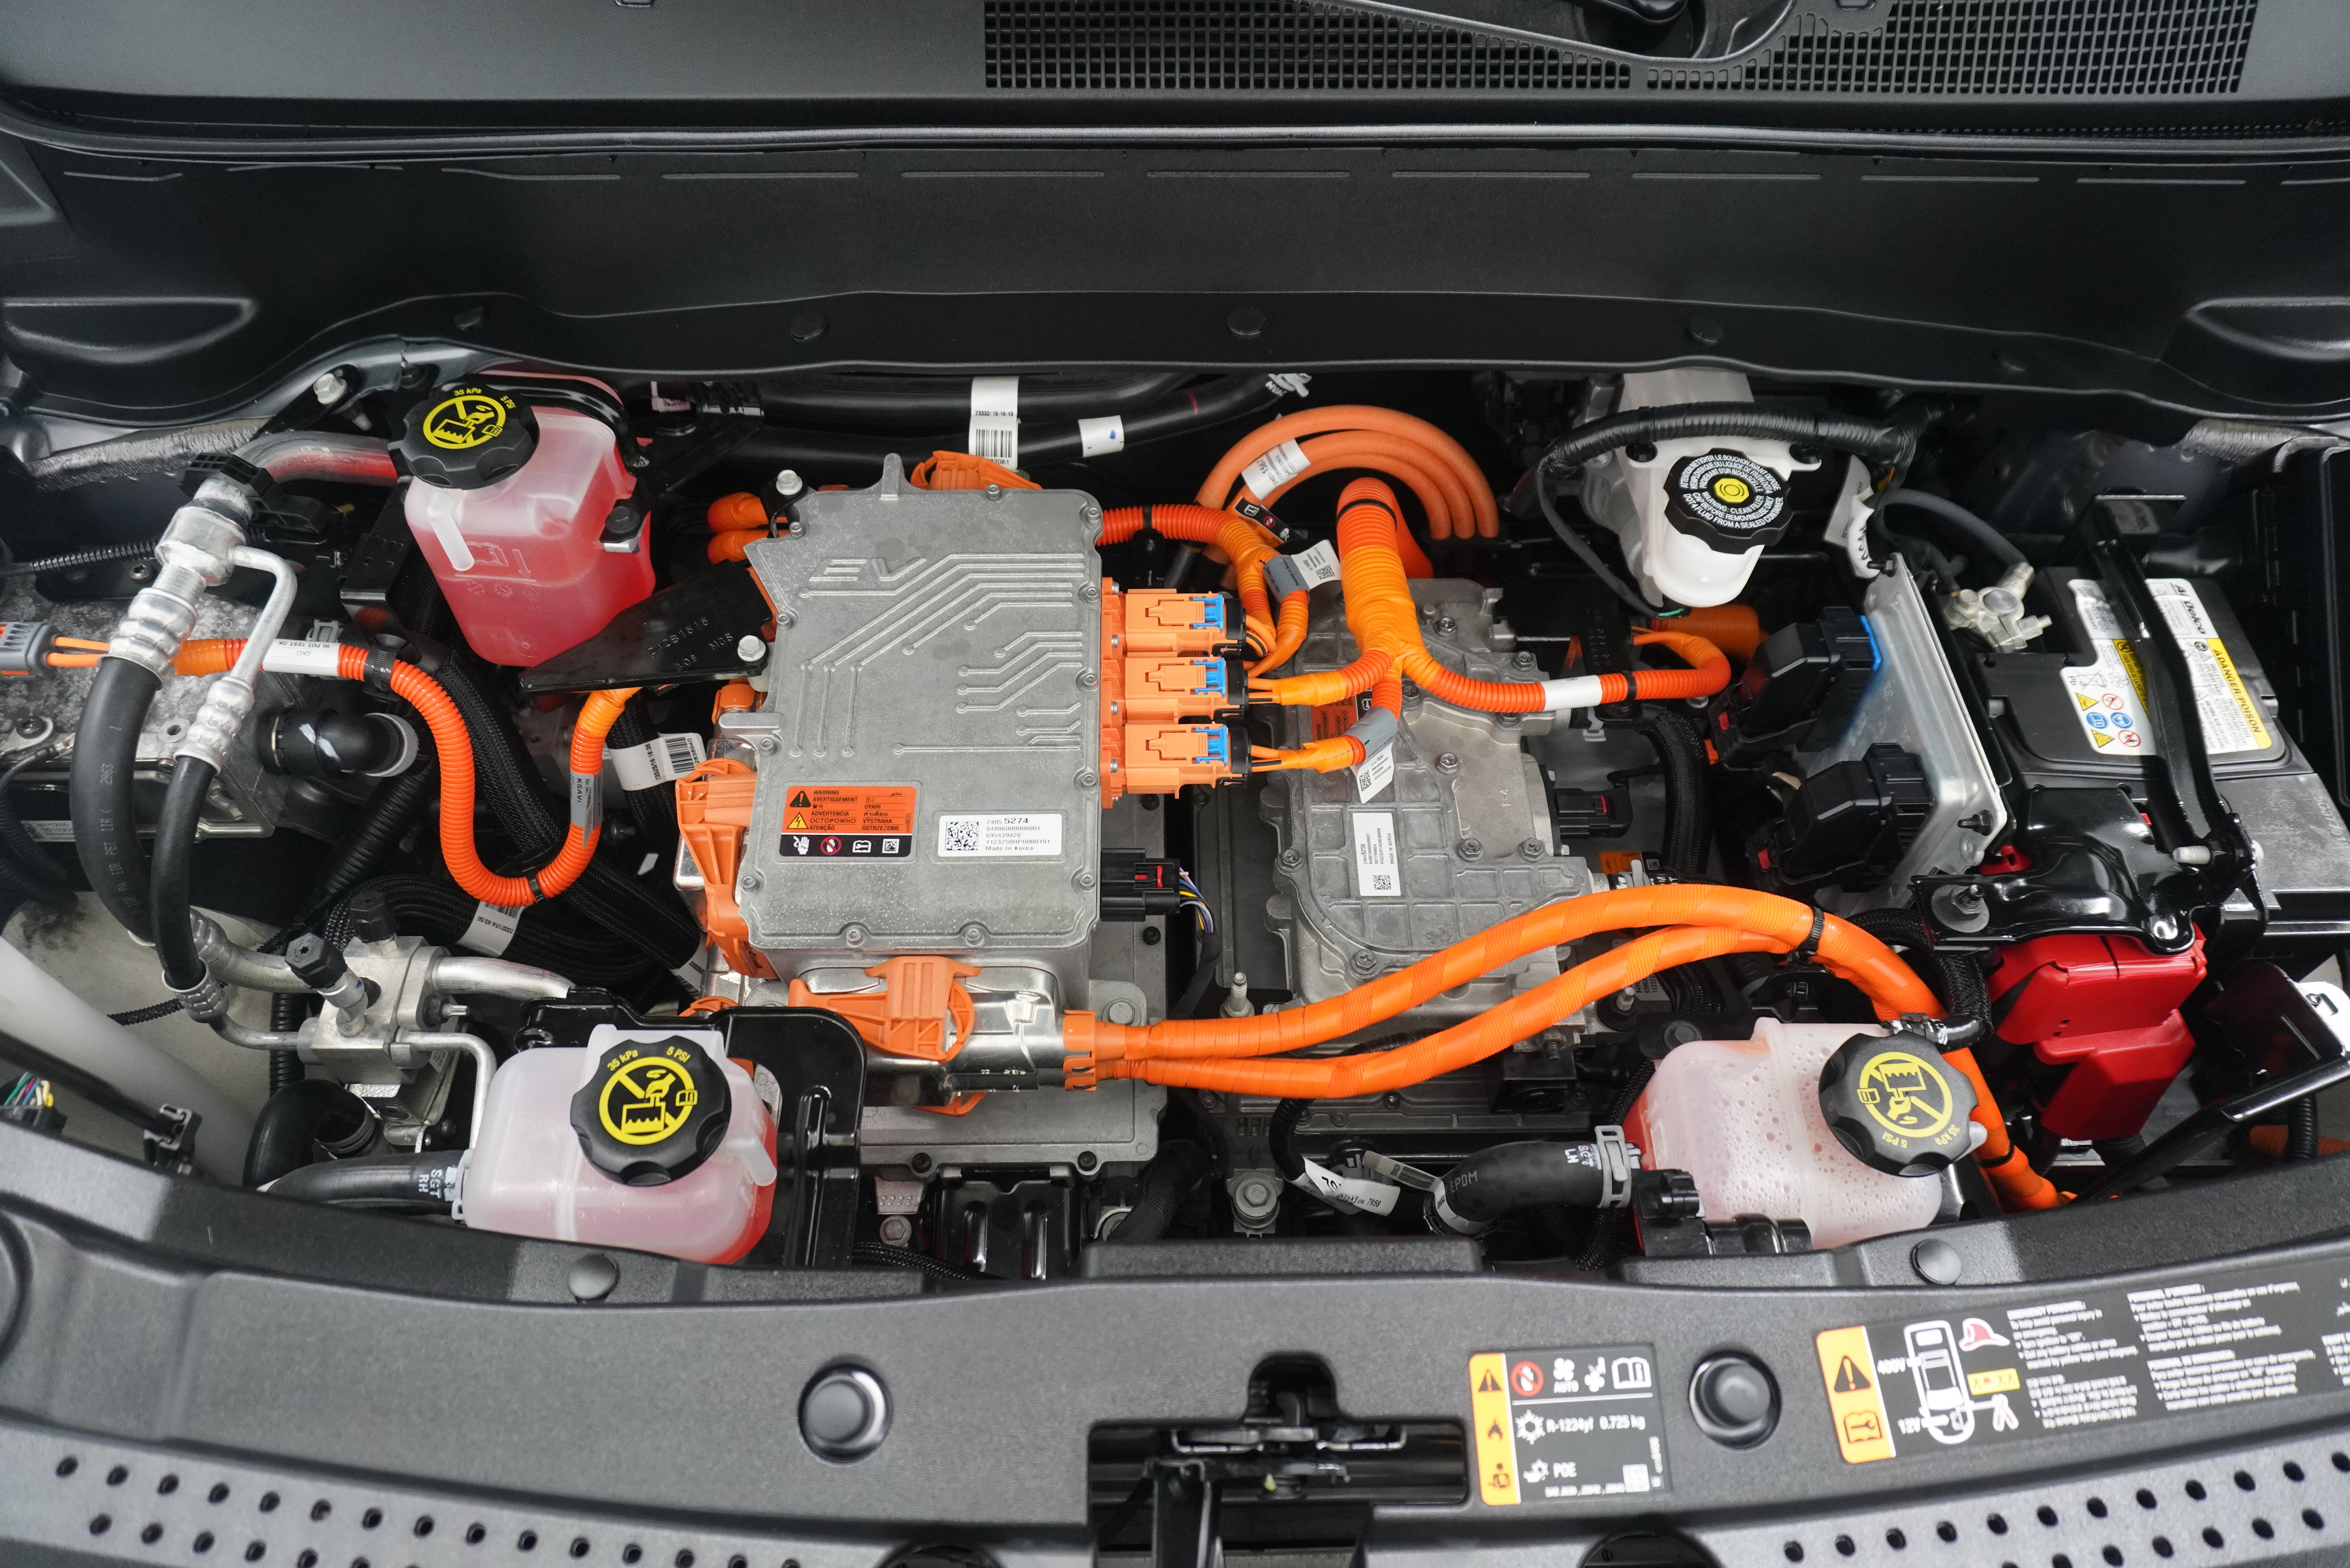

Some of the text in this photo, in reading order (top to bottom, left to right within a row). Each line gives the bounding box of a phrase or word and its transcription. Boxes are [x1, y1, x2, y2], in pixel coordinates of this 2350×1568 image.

[504, 399, 517, 409] PSI
[1722, 455, 1750, 466] BOUCHON
[1748, 462, 1768, 475] AVANT
[1722, 461, 1744, 470] LIQUIDE
[1743, 465, 1752, 474] DE
[1750, 470, 1766, 482] FREIN
[1731, 467, 1749, 479] BIDON
[1747, 475, 1764, 493] SCELLE
[1683, 493, 1697, 505] DOT
[1694, 504, 1715, 520] FLUID
[1713, 516, 1734, 528] FROM
[1740, 518, 1767, 529] SEALED
[1763, 496, 1784, 523] CONTAINER
[1692, 492, 1703, 503] CAP
[1700, 501, 1726, 518] BEFORE
[1764, 495, 1774, 511] ONLY
[1730, 506, 1753, 514] CLEAN
[1750, 494, 1765, 511] FILLER
[2068, 676, 2077, 686] Pb
[2217, 657, 2263, 733] DANGER/POISON
[607, 1049, 638, 1071] 35 kPa
[666, 1045, 691, 1063] 5 PSI
[1881, 1131, 1908, 1150] 5 PSI
[1933, 1124, 1961, 1146] 35 kPa
[418, 1174, 430, 1193] RH
[1877, 1357, 1906, 1375] 400V
[1553, 1380, 1579, 1393] AUTO
[1546, 1414, 1646, 1433] R-1234yf 0.725 kg
[1897, 1416, 1921, 1434] 12V
[1553, 1461, 1577, 1478] POE
